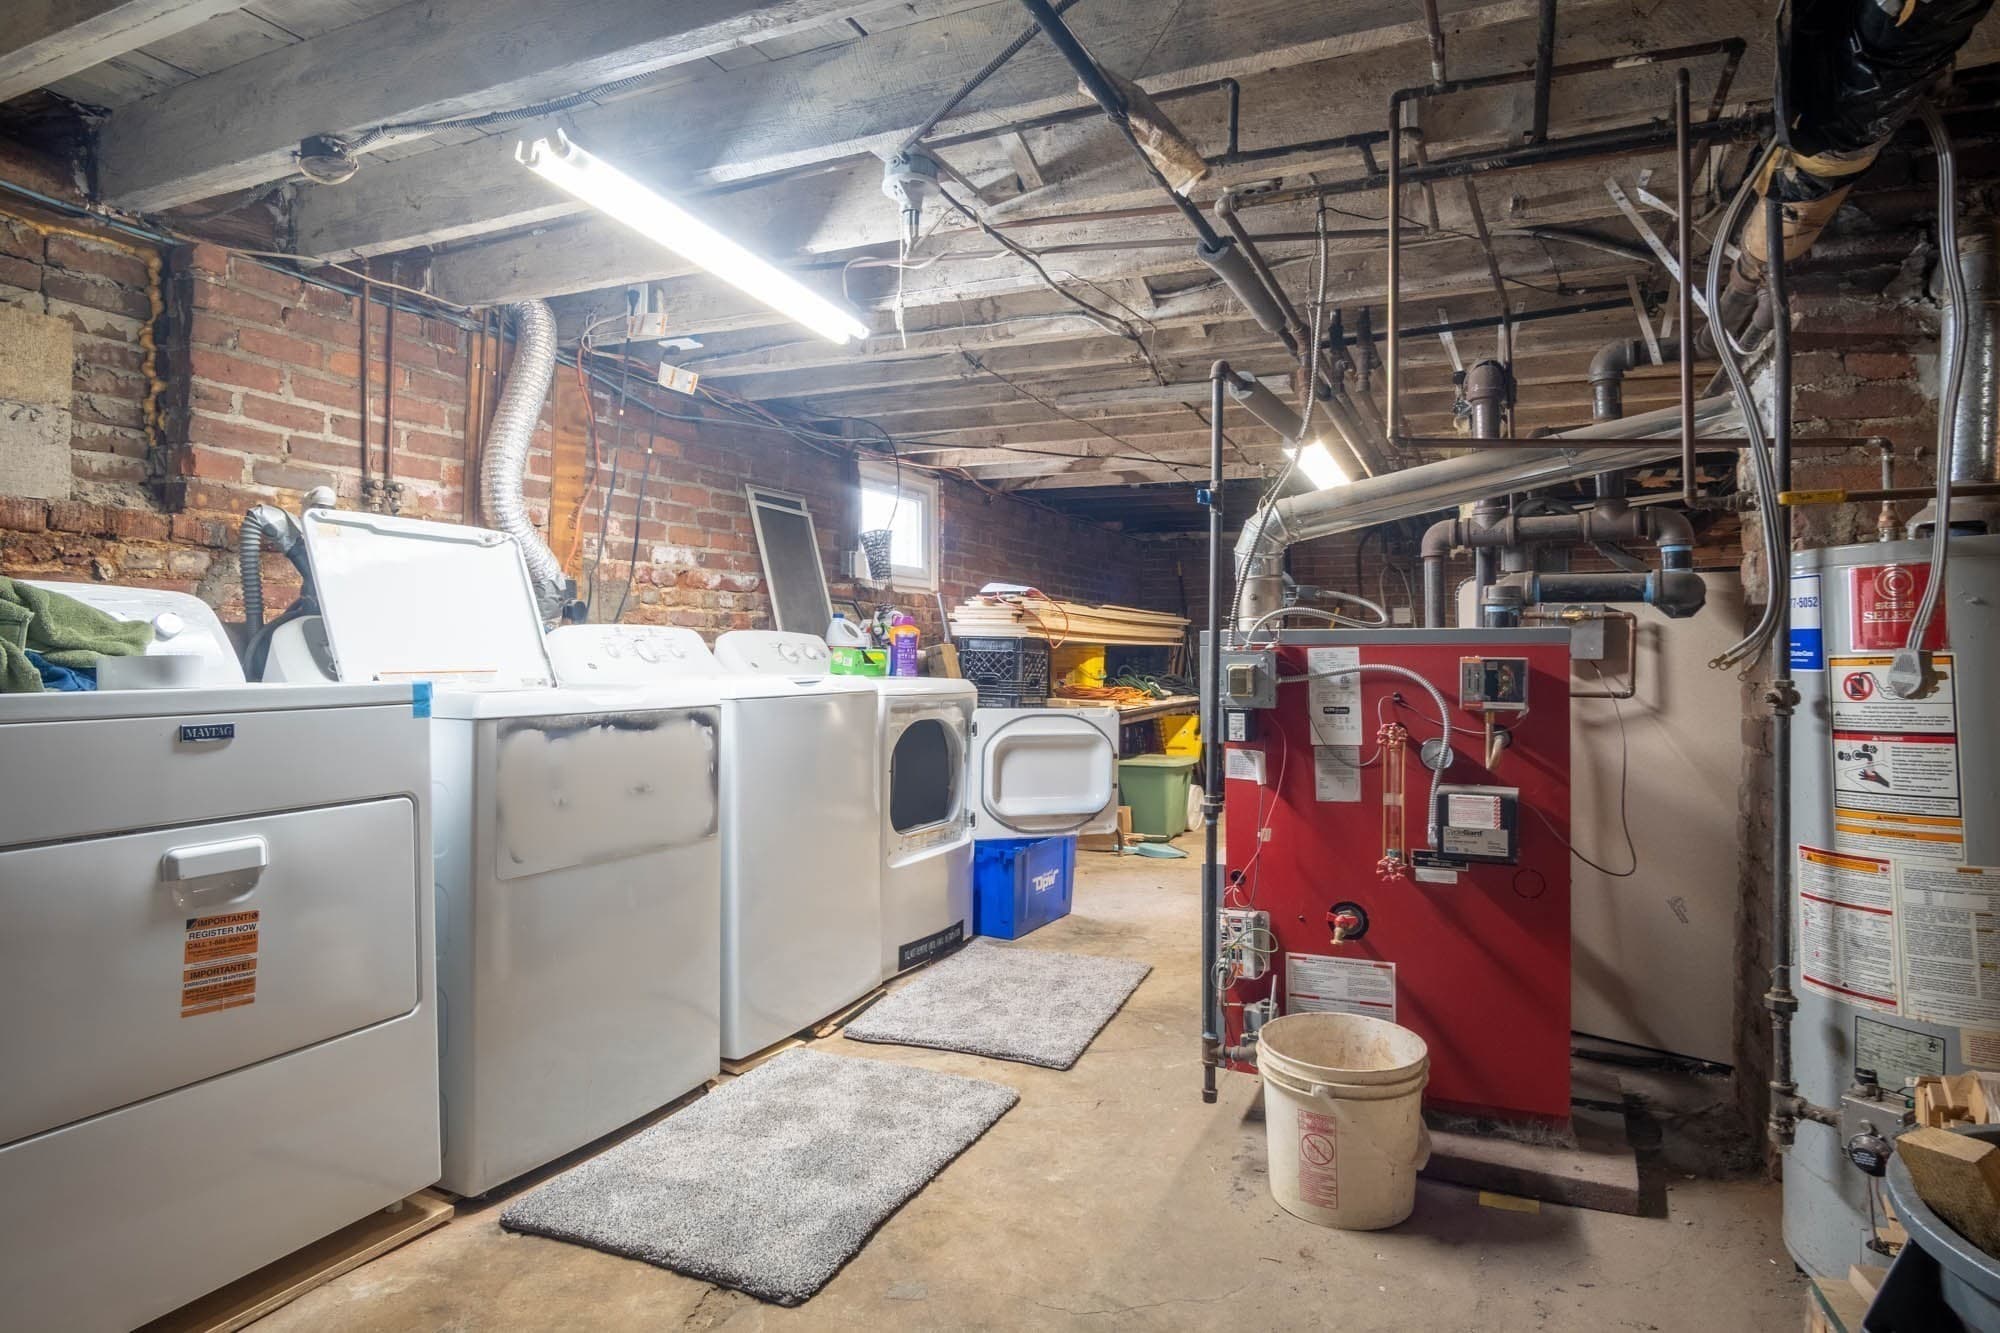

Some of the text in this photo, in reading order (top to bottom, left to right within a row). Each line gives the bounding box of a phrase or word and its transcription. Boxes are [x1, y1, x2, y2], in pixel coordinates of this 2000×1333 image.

[1863, 611, 1914, 620] SELEC
[185, 726, 233, 738] MAYTAG
[197, 913, 252, 927] IMPORTANT!
[188, 923, 257, 940] REGISTER NOW
[187, 941, 208, 950] CALL
